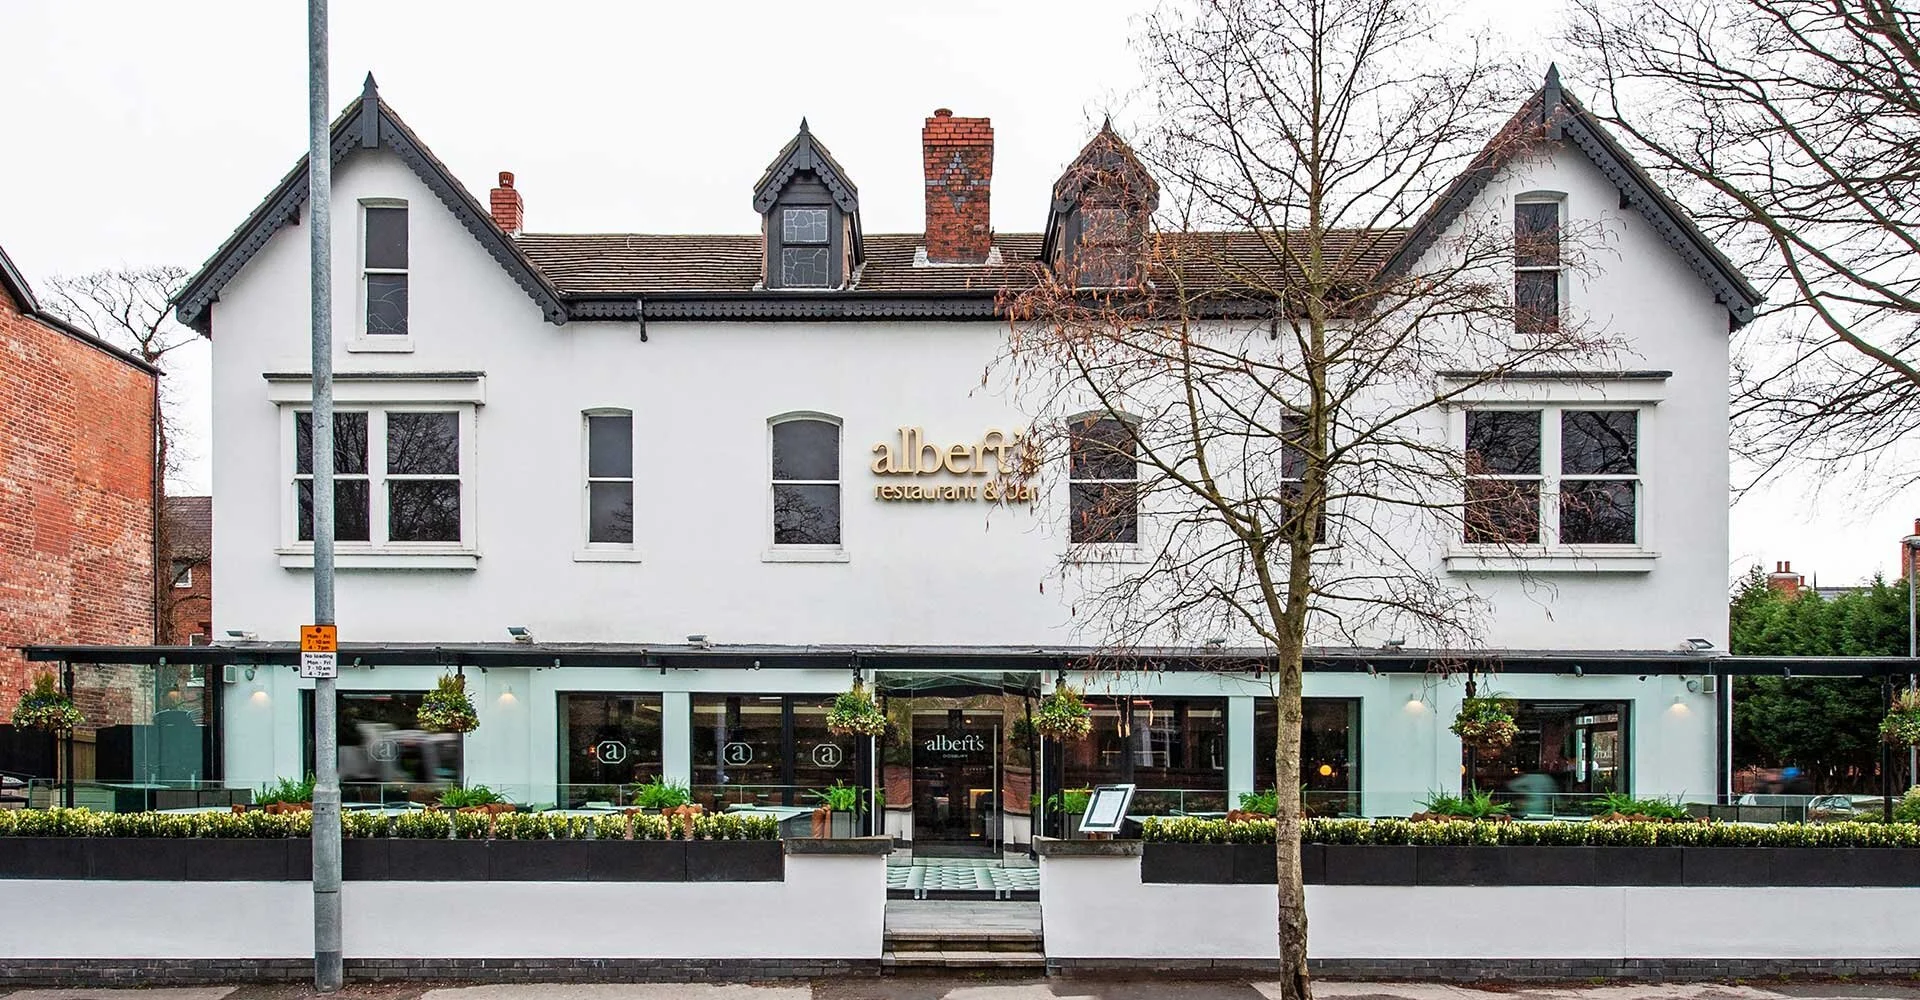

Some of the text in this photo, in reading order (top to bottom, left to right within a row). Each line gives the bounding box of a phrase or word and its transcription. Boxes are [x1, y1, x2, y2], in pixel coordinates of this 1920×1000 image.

[875, 481, 977, 500] restaurant
[983, 479, 1001, 500] &
[379, 743, 392, 758] a
[926, 734, 985, 751] albert's
[605, 743, 621, 759] a
[731, 745, 746, 761] a
[821, 746, 836, 763] a
